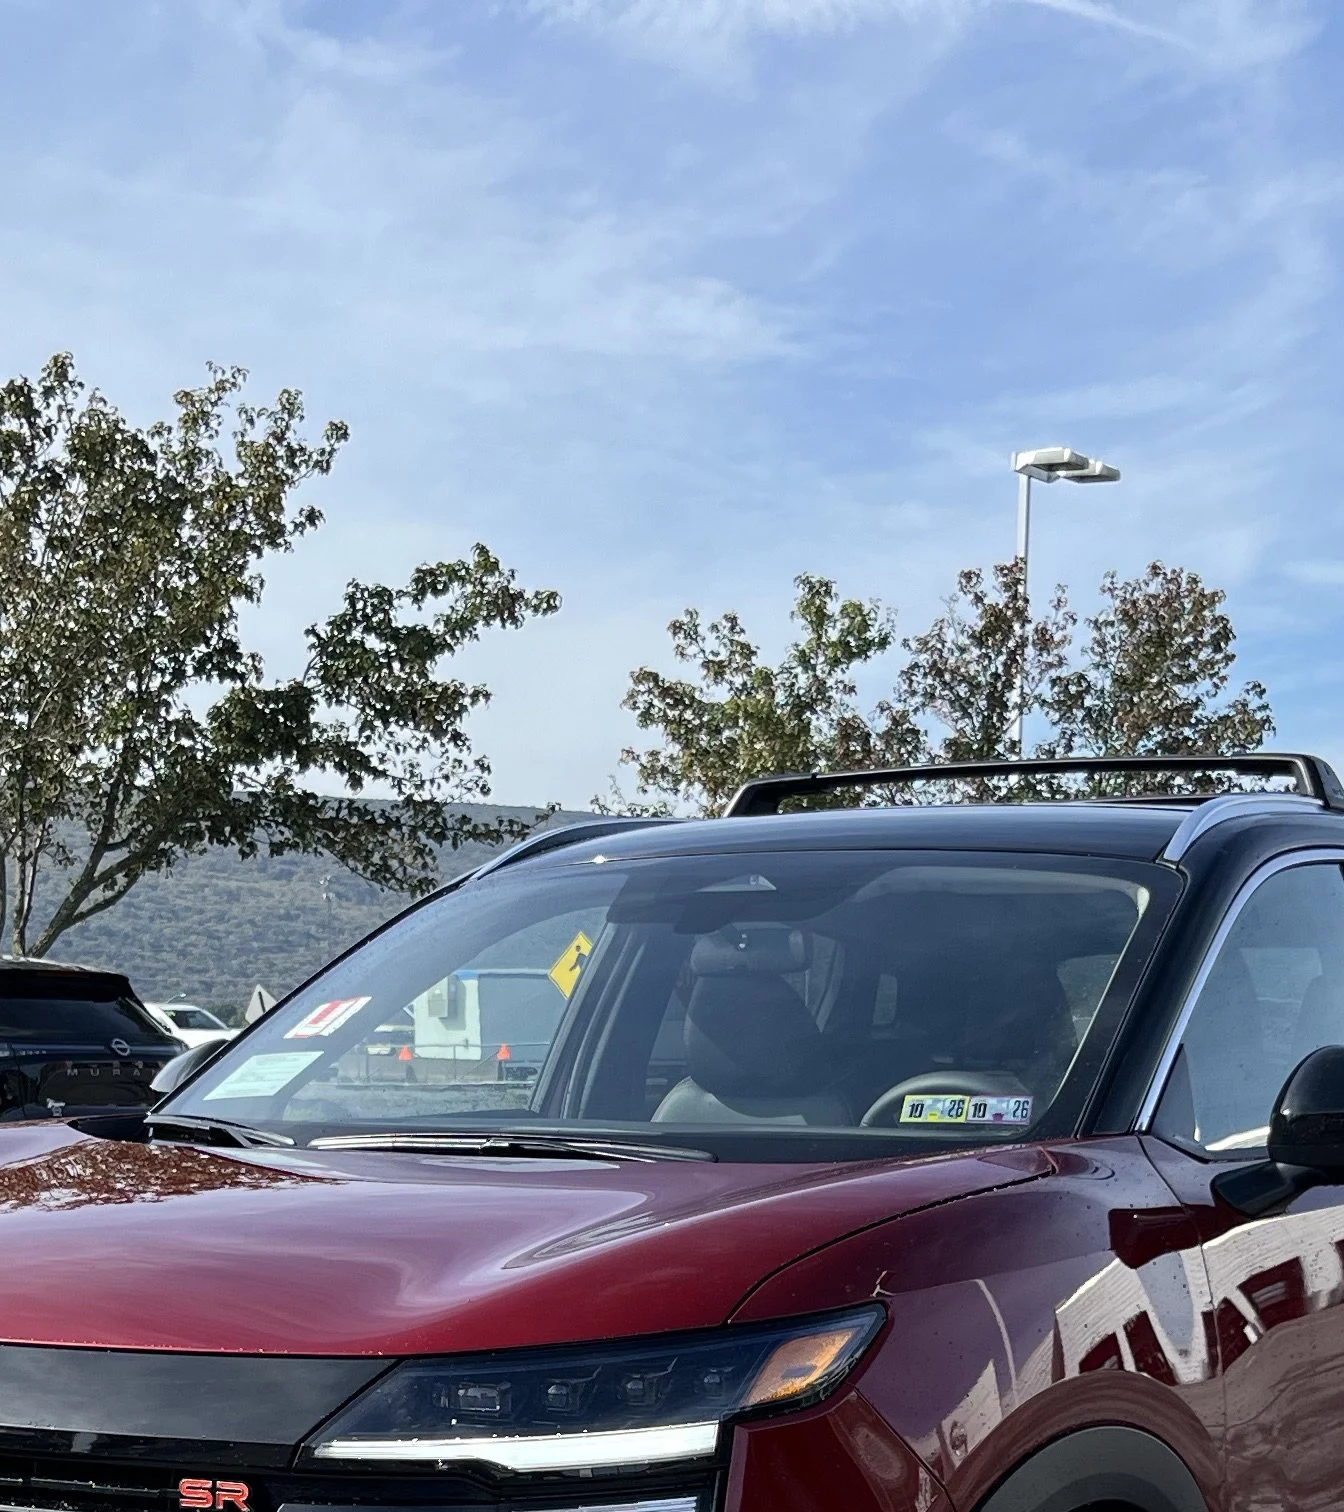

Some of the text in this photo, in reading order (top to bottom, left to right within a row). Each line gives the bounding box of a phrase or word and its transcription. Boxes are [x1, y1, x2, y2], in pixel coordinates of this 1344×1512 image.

[67, 1068, 156, 1077] MURA
[908, 1100, 965, 1118] 10 26
[971, 1100, 1030, 1119] 10 26
[178, 1478, 251, 1512] SR
